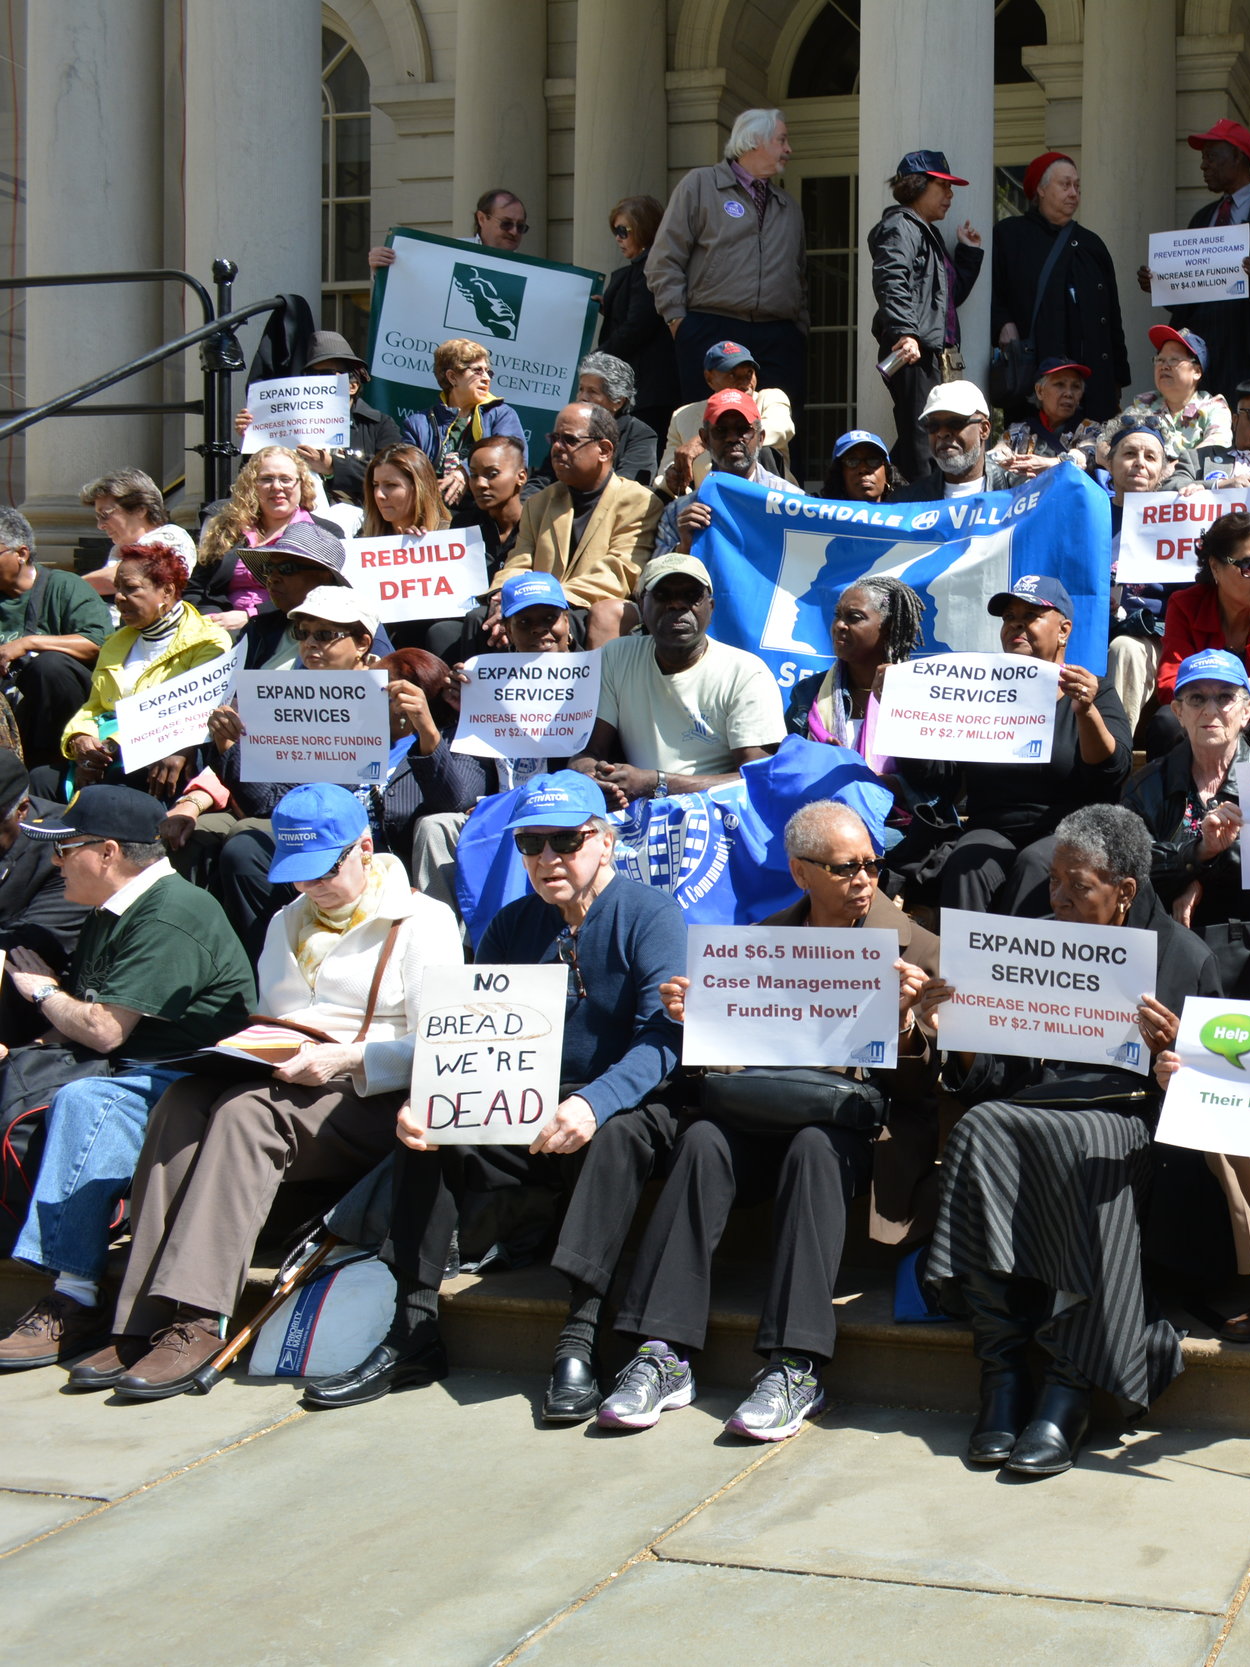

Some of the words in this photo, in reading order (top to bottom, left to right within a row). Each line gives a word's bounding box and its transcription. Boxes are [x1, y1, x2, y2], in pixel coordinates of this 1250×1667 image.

[1174, 238, 1197, 247] ELDER
[1199, 236, 1224, 244] ABUSE
[1154, 249, 1200, 259] PREVENTION
[1202, 245, 1244, 254] PROGRAMS
[1185, 258, 1210, 266] WORK!
[1157, 271, 1192, 280] INCREASE
[1206, 266, 1239, 275] FUNDING
[1181, 281, 1195, 289] $4.0
[1197, 279, 1227, 287] MILLION
[385, 331, 440, 354] GODD
[260, 387, 299, 400] EXPAND
[303, 386, 336, 395] NORC
[497, 375, 561, 396] CENTER
[271, 401, 323, 413] SERVICES
[253, 421, 285, 431] INCREASE
[765, 491, 903, 527] ROCHDALE
[949, 492, 1040, 529] VILLAGE
[361, 543, 465, 568] REBUILD
[380, 576, 454, 601] DFTA
[478, 667, 542, 679] EXPAND
[548, 665, 590, 679] NORC
[913, 663, 986, 680] EXPAND
[991, 666, 1038, 681] NORC
[139, 681, 198, 711] EXPAND
[202, 657, 238, 685] NORC
[257, 686, 315, 699] EXPAND
[320, 687, 365, 699] NORC
[158, 681, 228, 719] SERVICES
[494, 688, 574, 701] SERVICES
[929, 686, 1017, 702] SERVICES
[274, 709, 350, 722] SERVICES
[470, 714, 516, 723] INCREASE
[520, 714, 552, 722] NORC
[555, 710, 593, 722] FUNDING
[891, 708, 952, 722] INCREASE
[956, 715, 990, 724] NORC
[994, 715, 1046, 725] FUNDING
[250, 735, 299, 745] INCREASE
[302, 736, 331, 745] NORC
[335, 737, 382, 746] FUNDING
[509, 728, 527, 738] $2.7
[531, 727, 573, 736] MILLION
[920, 727, 936, 736] BY
[939, 728, 963, 738] $2.7
[966, 730, 1014, 740] MILLION
[276, 751, 288, 760] BY
[292, 751, 311, 761] $2.7
[315, 752, 356, 760] MILLION
[703, 944, 738, 958] Add
[745, 945, 785, 960] $6.5
[792, 946, 855, 959] Million
[861, 947, 880, 959] to
[969, 932, 1055, 957] EXPAND
[1062, 942, 1127, 965] NORC
[473, 973, 509, 992] NO
[703, 975, 750, 988] Case
[757, 975, 881, 992] Management
[992, 964, 1100, 992] SERVICES
[727, 1003, 802, 1020] Funding
[810, 1004, 858, 1018] Now!
[951, 992, 1024, 1011] INCREASE
[1029, 1002, 1070, 1016] NORC
[1075, 1007, 1141, 1024] FUNDING
[426, 1013, 523, 1038] BREAD
[989, 1015, 1007, 1026] BY
[1011, 1017, 1040, 1031] $2.7
[1045, 1022, 1104, 1038] MILLION
[1213, 1026, 1249, 1043] Help
[435, 1047, 536, 1076] WE'RE
[1200, 1091, 1243, 1107] Their
[427, 1088, 543, 1129] DEAD
[286, 1311, 302, 1346] PRIORITY
[293, 1328, 304, 1348] MAIL
